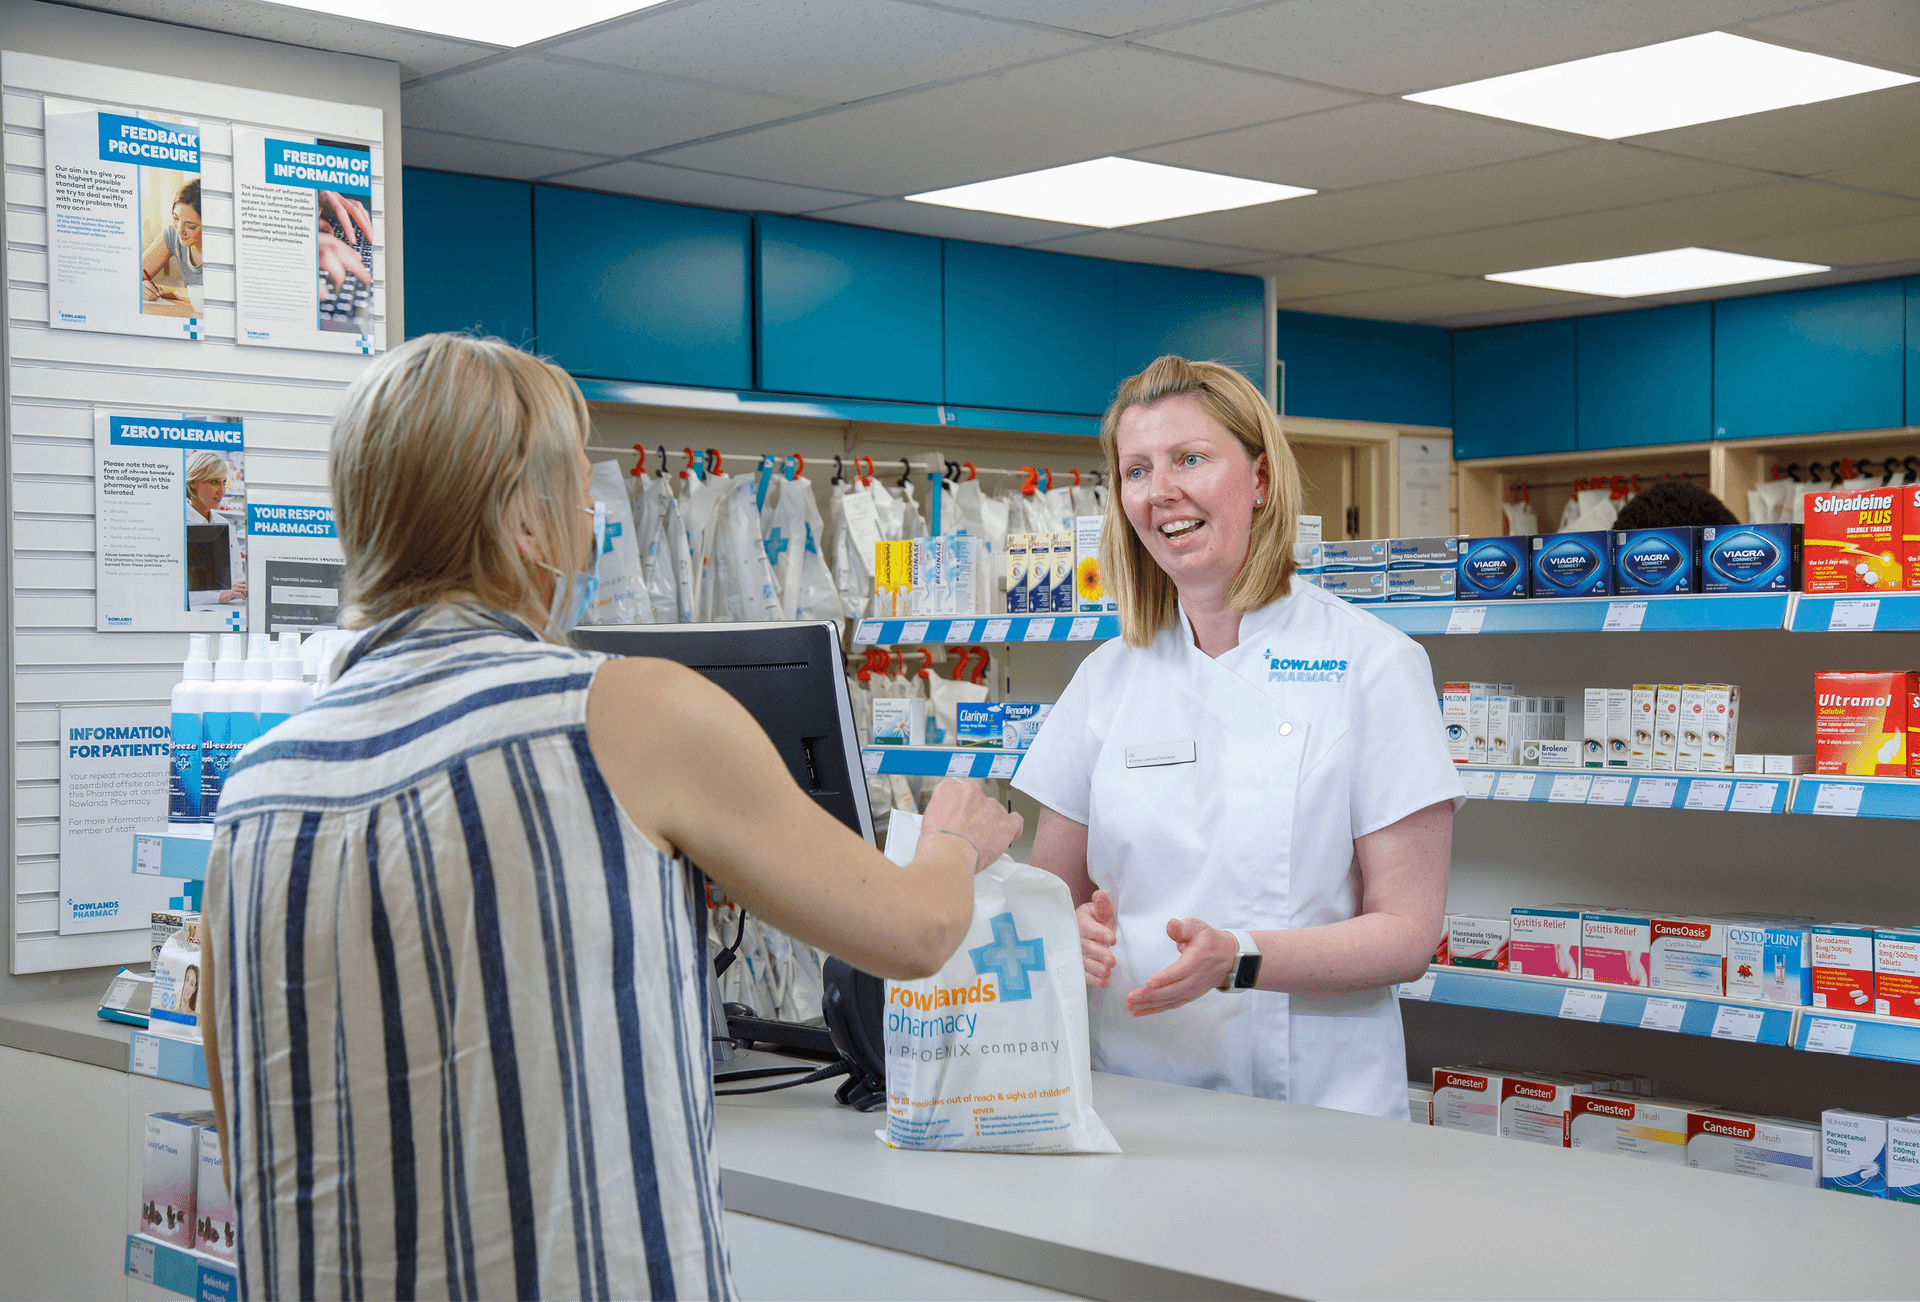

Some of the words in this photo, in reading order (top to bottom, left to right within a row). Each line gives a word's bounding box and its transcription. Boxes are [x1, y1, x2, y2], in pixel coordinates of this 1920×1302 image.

[121, 125, 197, 148] FEEDBACK
[109, 139, 198, 163] PROCEDURE
[283, 149, 349, 170] FREEDOM
[350, 158, 369, 172] OF
[68, 174, 93, 182] highest
[273, 163, 369, 188] INFORMATION
[56, 181, 86, 189] standard
[86, 199, 112, 207] problem
[102, 194, 124, 202] swiftly
[121, 425, 160, 439] ZERO
[161, 427, 241, 444] TOLERANCE
[116, 475, 150, 483] colleagues
[1813, 494, 1892, 515] Solpadeine
[254, 507, 287, 519] YOUR
[1859, 510, 1892, 525] PLUS
[254, 522, 331, 534] PHARMACIST
[1634, 554, 1670, 562] VIAGRA
[1723, 550, 1765, 558] VIAGRA
[1473, 560, 1507, 568] VIAGRA
[1550, 557, 1586, 565] VIAGRA
[1270, 659, 1347, 670] ROWLANDS
[1268, 671, 1345, 683] PHARMACY
[1818, 694, 1892, 707] Ultramol
[1006, 706, 1033, 716] Benadryl
[960, 710, 988, 723] Clarityn
[69, 726, 171, 740] INFORMATION
[69, 745, 100, 758] FOR
[102, 743, 169, 757] PATIENTS
[1542, 745, 1567, 753] Brolene
[90, 772, 116, 781] repeat
[69, 782, 115, 790] assembled
[87, 790, 127, 799] Pharmacy
[69, 800, 108, 808] Rowlands
[69, 827, 102, 835] member
[73, 901, 119, 911] ROWLANDS
[73, 909, 118, 919] PHARMACY
[1513, 917, 1541, 929] Cystitis
[1544, 920, 1566, 929] Relief
[1585, 923, 1613, 935] Cystitis
[1614, 926, 1636, 936] Relief
[1655, 924, 1705, 937] CanesOasis
[1730, 929, 1799, 946] CYSTOPURIN
[1815, 936, 1849, 945] Co-codamol
[1664, 939, 1685, 948] Cystitis
[1879, 942, 1915, 951] Co-codamol
[1879, 950, 1918, 961] 8mg/500mg
[1879, 958, 1901, 966] Tablets
[890, 978, 996, 1011] rowlands
[889, 1009, 977, 1038] pharmacy
[981, 1040, 1059, 1055] company
[1447, 1075, 1483, 1088] Canesten
[964, 1095, 972, 1103] of
[974, 1093, 995, 1102] reach
[1006, 1092, 1026, 1102] sight
[1039, 1087, 1070, 1098] children
[1447, 1092, 1464, 1100] Thrush
[1515, 1084, 1551, 1098] Canesten
[1515, 1101, 1531, 1109] Thrush
[1587, 1101, 1630, 1117] Canesten
[1638, 1109, 1660, 1121] Thrush
[1826, 1119, 1853, 1128] NUMARK
[1703, 1120, 1749, 1137] Canesten
[1758, 1131, 1781, 1143] Thrush
[1827, 1131, 1866, 1142] Paracetamol
[1827, 1138, 1847, 1148] 500mg
[1827, 1146, 1850, 1155] Caplets
[1893, 1147, 1915, 1156] 500mg
[1893, 1155, 1919, 1164] Caplets
